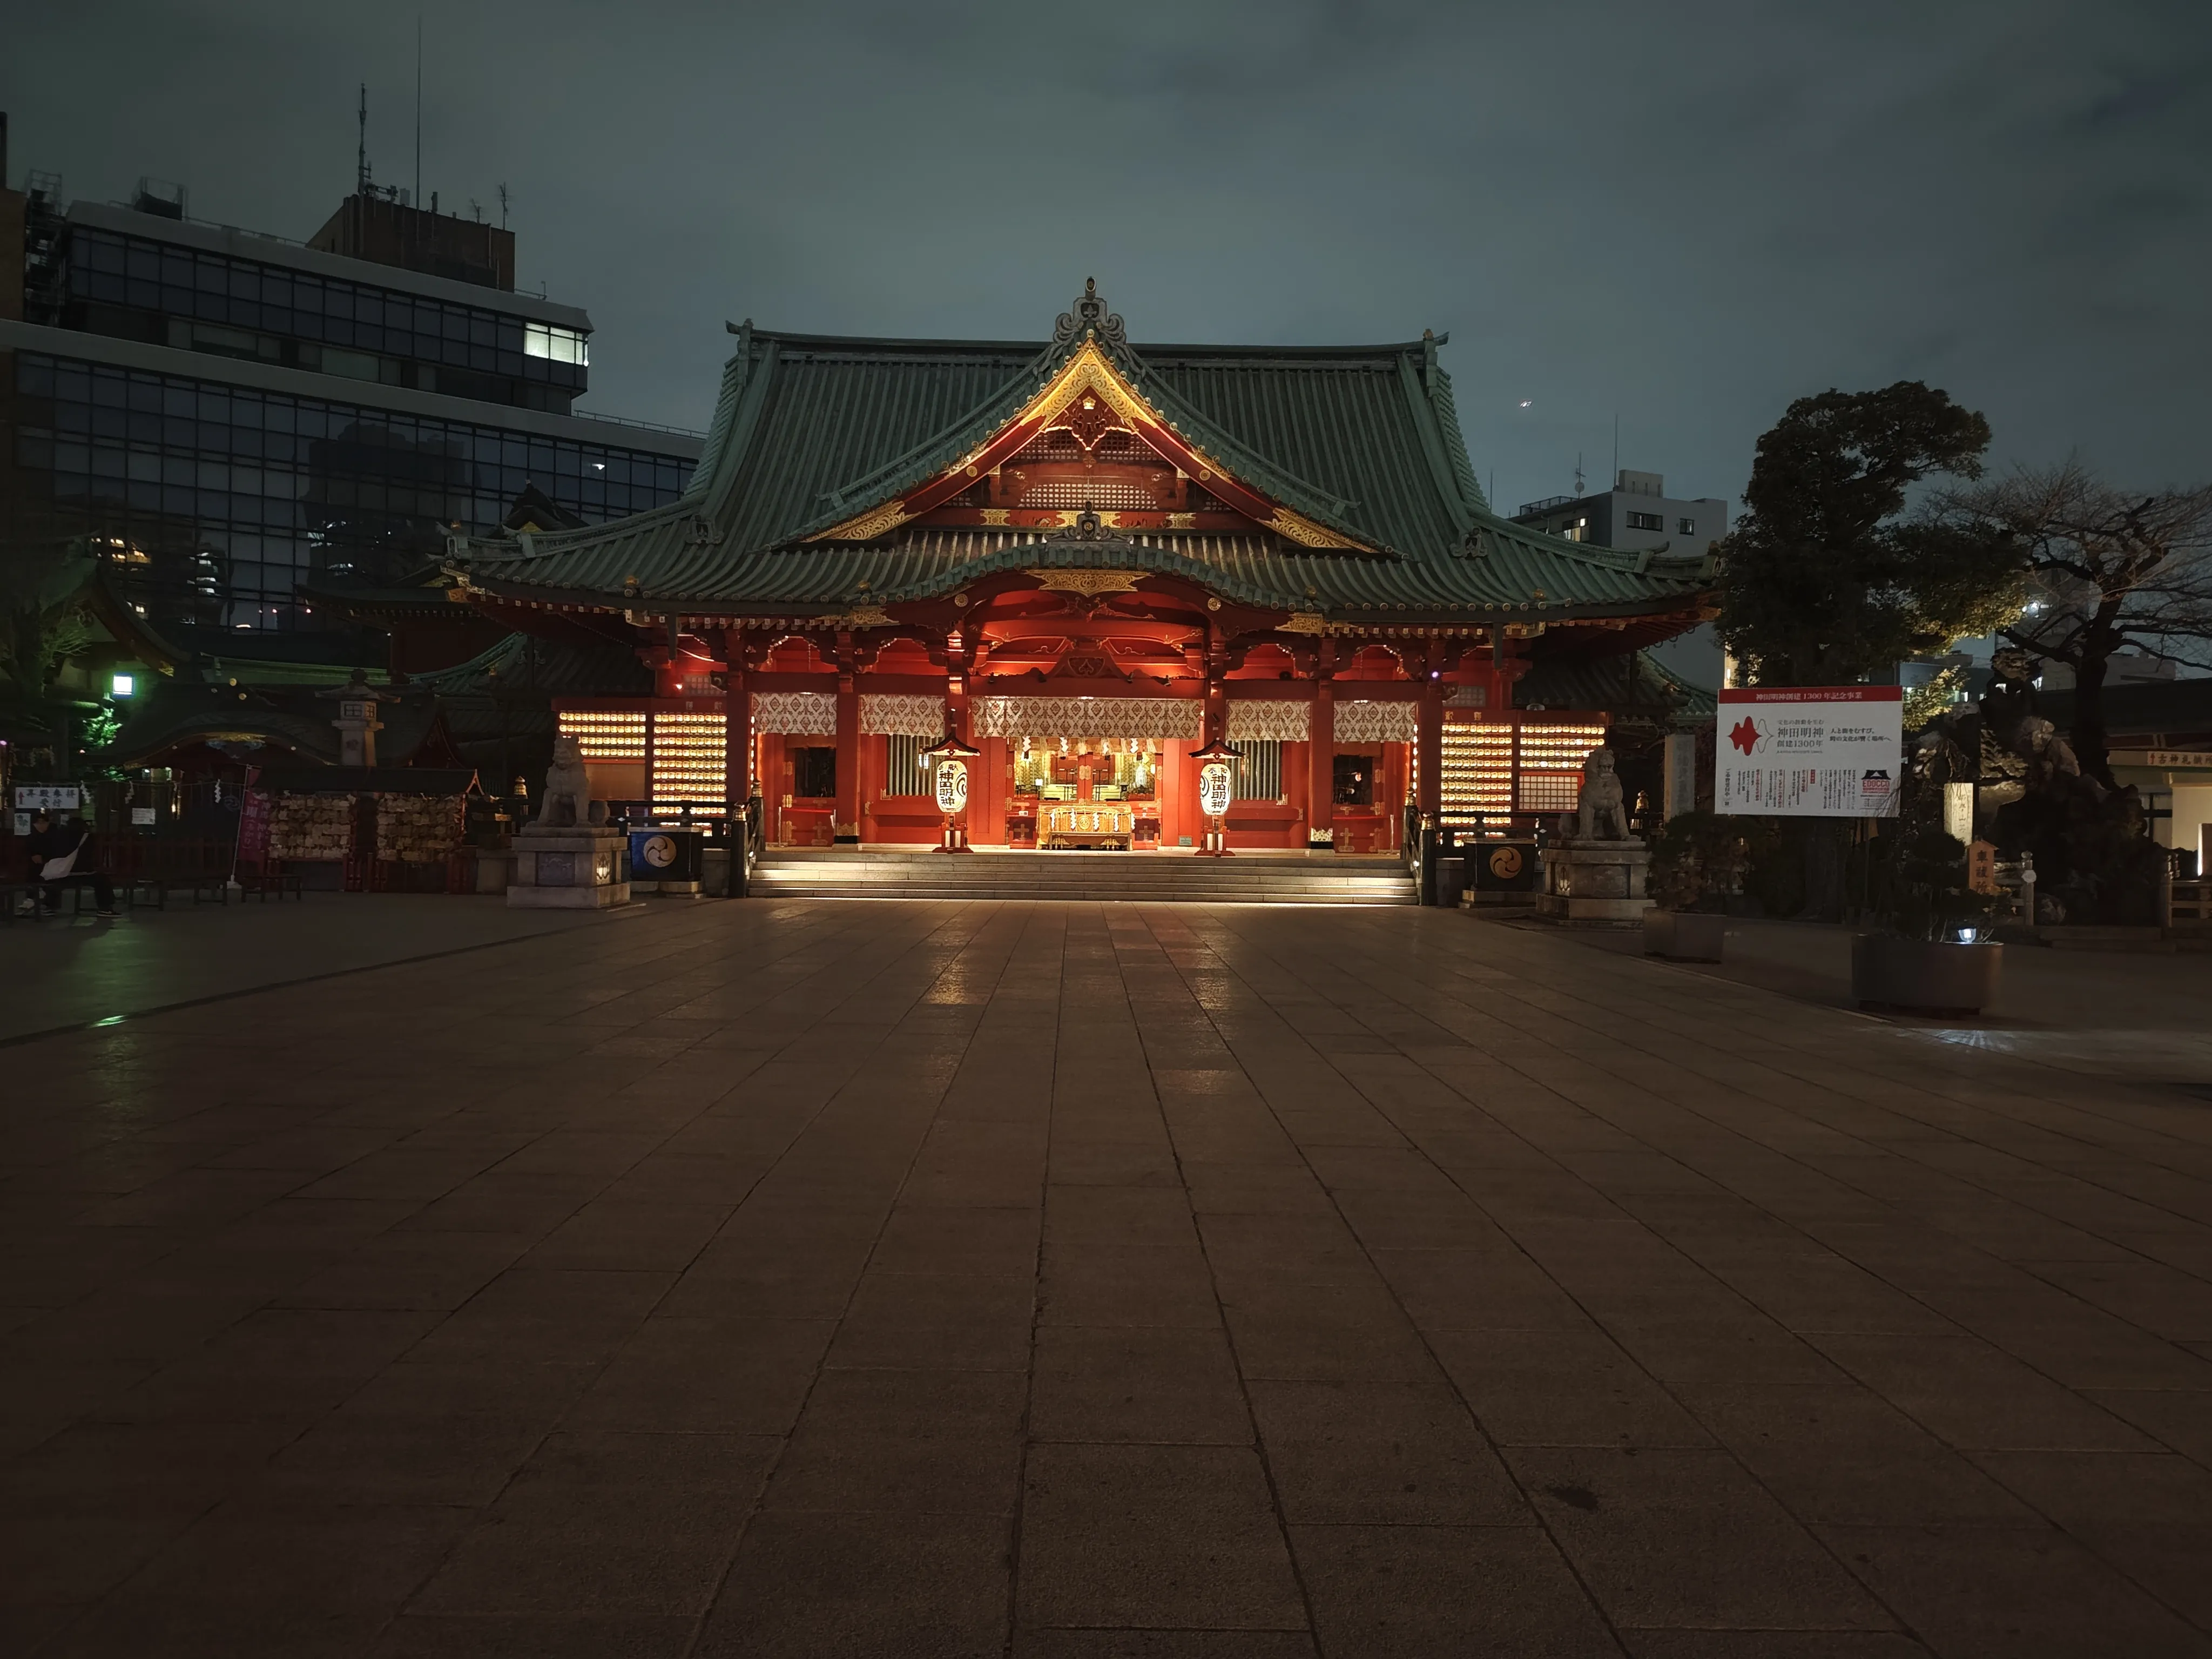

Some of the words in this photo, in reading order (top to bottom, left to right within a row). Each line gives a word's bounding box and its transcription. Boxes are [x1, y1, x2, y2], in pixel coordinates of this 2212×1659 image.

[1777, 727, 1824, 738] 神田明神
[939, 771, 955, 806] 神田明神
[1210, 774, 1227, 808] 神田明神
[39, 798, 62, 807] 受付
